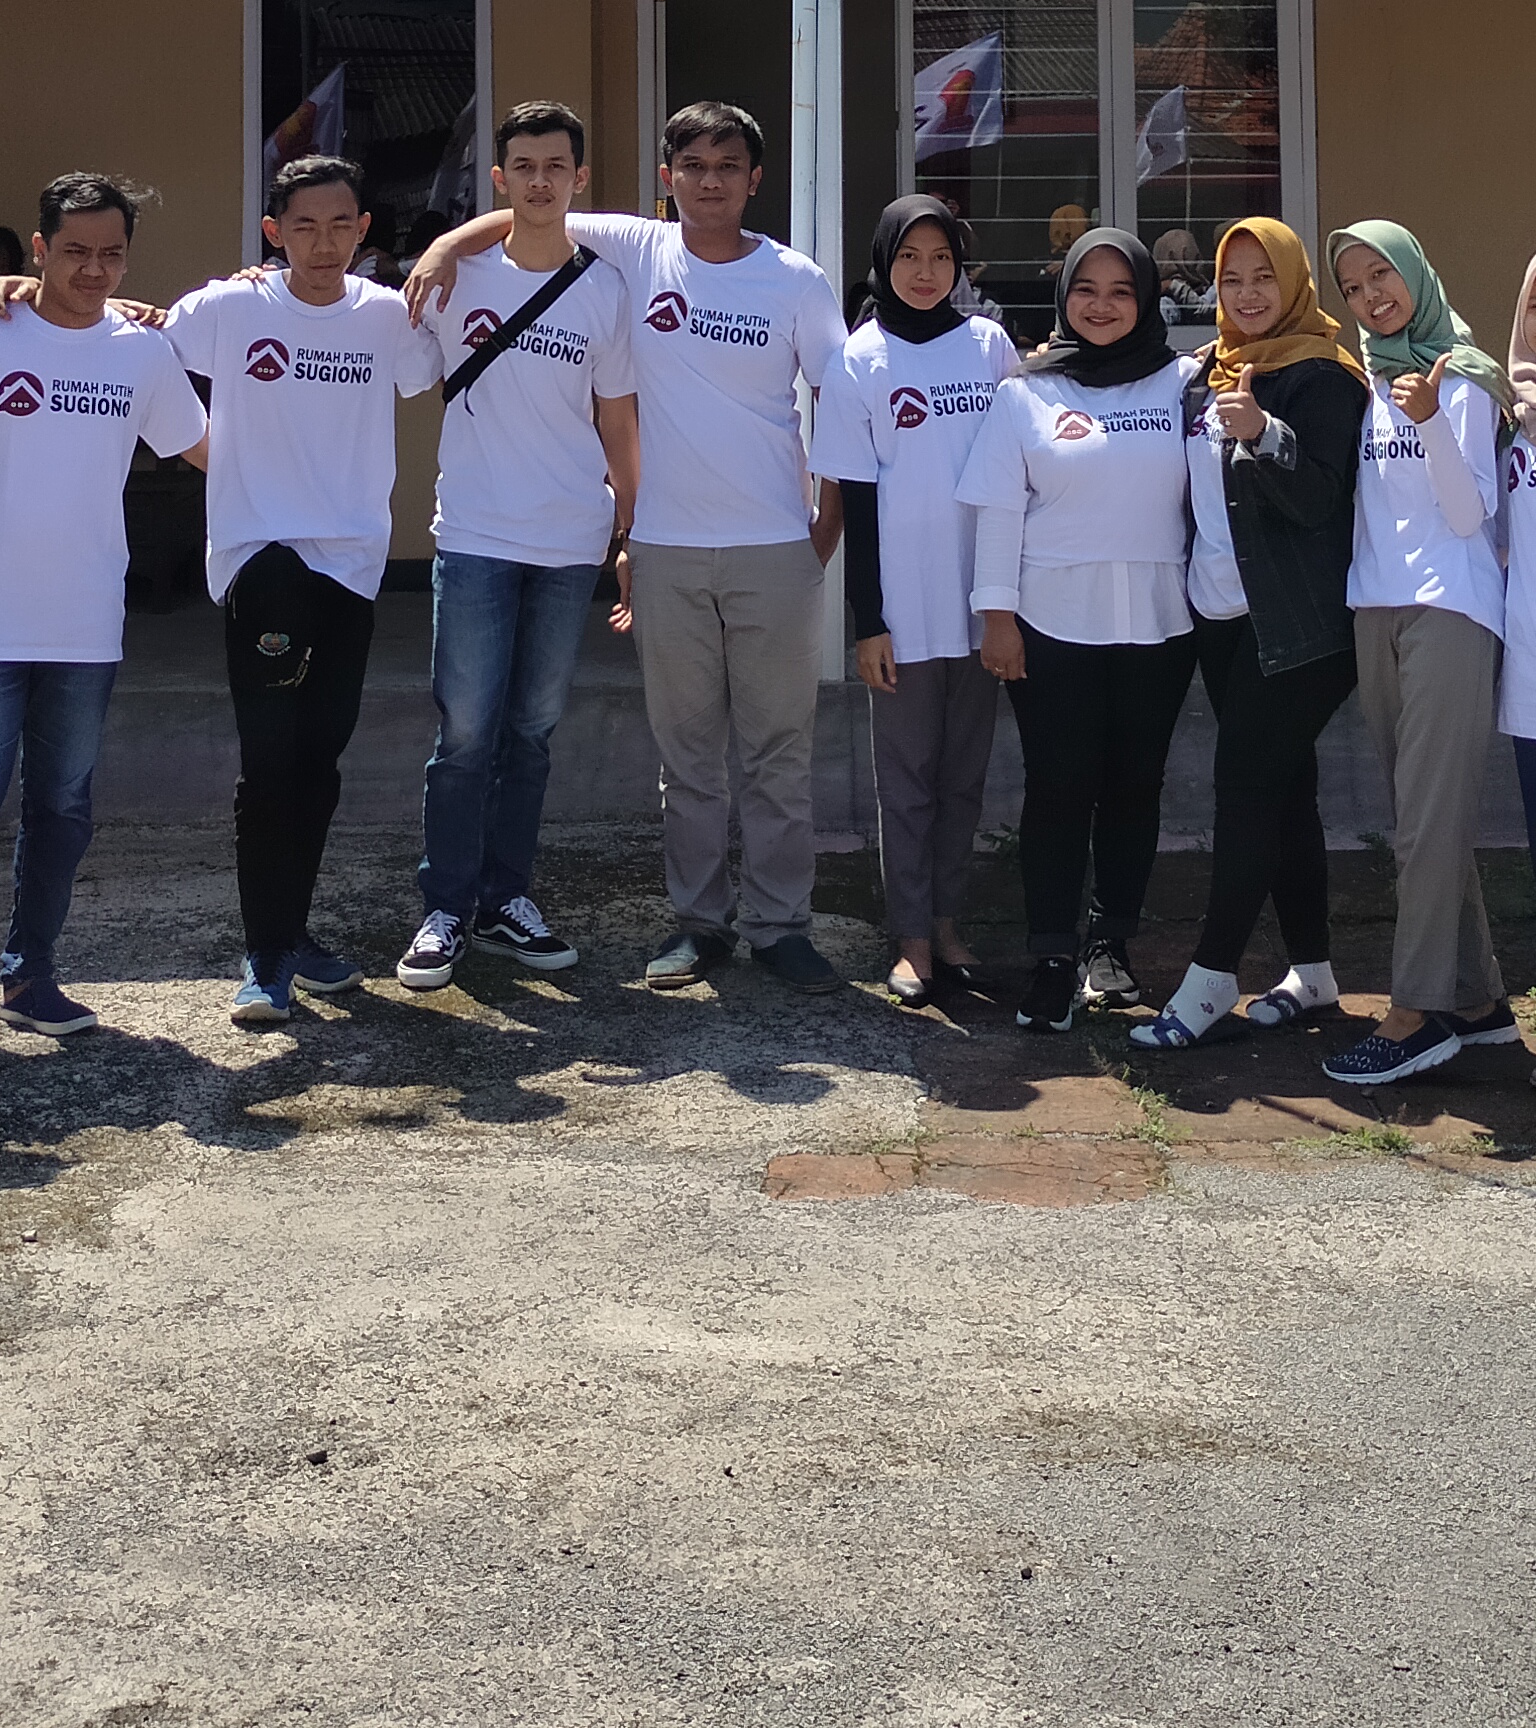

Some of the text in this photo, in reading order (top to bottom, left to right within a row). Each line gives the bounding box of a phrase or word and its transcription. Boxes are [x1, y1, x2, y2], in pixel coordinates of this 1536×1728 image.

[691, 306, 770, 328] RUMAH PUTIH
[556, 328, 589, 347] PUTIH
[690, 318, 768, 347] SUGIONO
[297, 348, 373, 365] RUMAH PUTIH
[294, 362, 372, 384] SUGIONO
[51, 379, 134, 399] RUMAH PUTIH
[930, 381, 973, 397] RUMAH
[49, 395, 131, 418] SUGIONO
[1098, 407, 1170, 422] RUMAH PUTIH
[1100, 417, 1171, 433] SUGIONO
